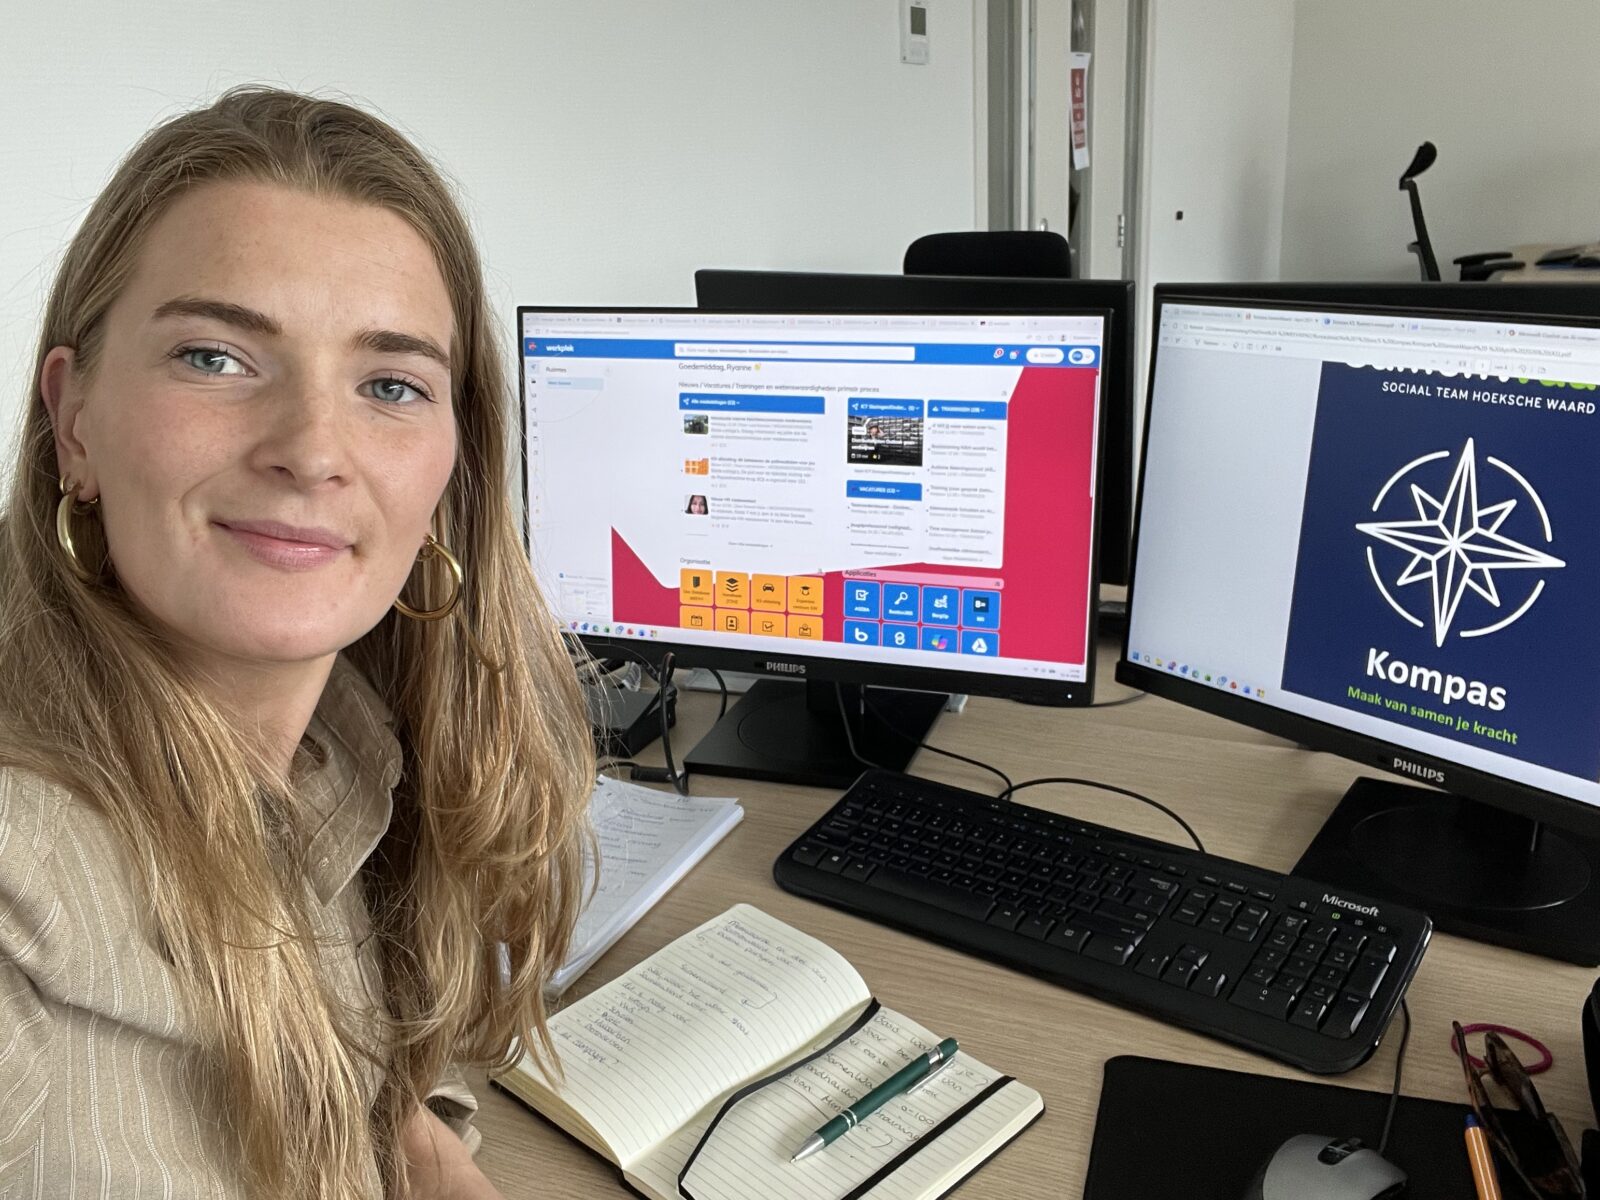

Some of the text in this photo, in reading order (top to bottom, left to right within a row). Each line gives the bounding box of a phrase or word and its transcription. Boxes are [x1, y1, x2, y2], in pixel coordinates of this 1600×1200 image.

[1381, 382, 1596, 414] SOCIAAL TEAM HOEKSCHE WAARD
[766, 661, 806, 674] PHILIPS
[1366, 647, 1508, 711] Kompas
[1347, 685, 1519, 745] Maak van samen je kracht
[1393, 758, 1446, 783] PHILIPS
[1321, 893, 1380, 917] Microsoft
